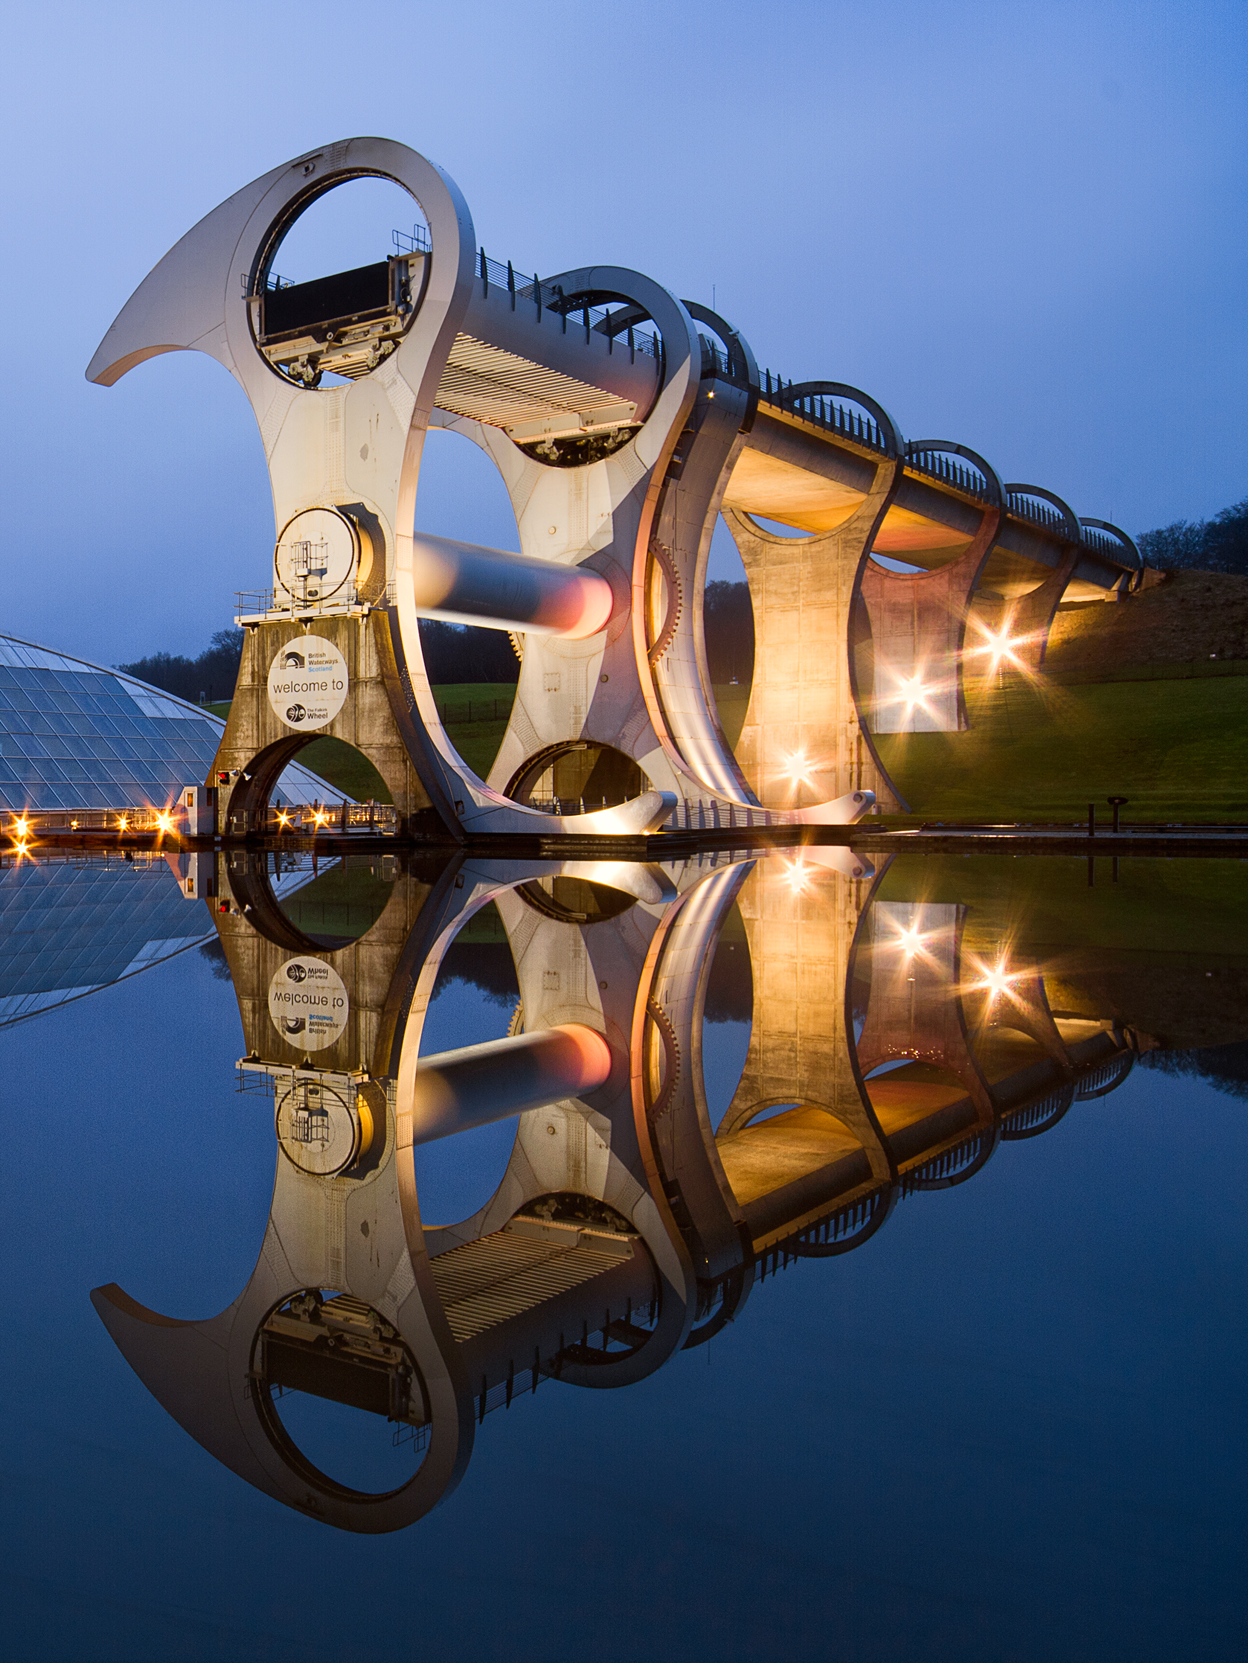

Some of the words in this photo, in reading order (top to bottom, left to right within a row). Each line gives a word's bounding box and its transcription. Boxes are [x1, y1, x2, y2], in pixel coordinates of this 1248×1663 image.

[308, 658, 338, 666] Waterways
[273, 681, 328, 693] welcome
[332, 679, 344, 690] to
